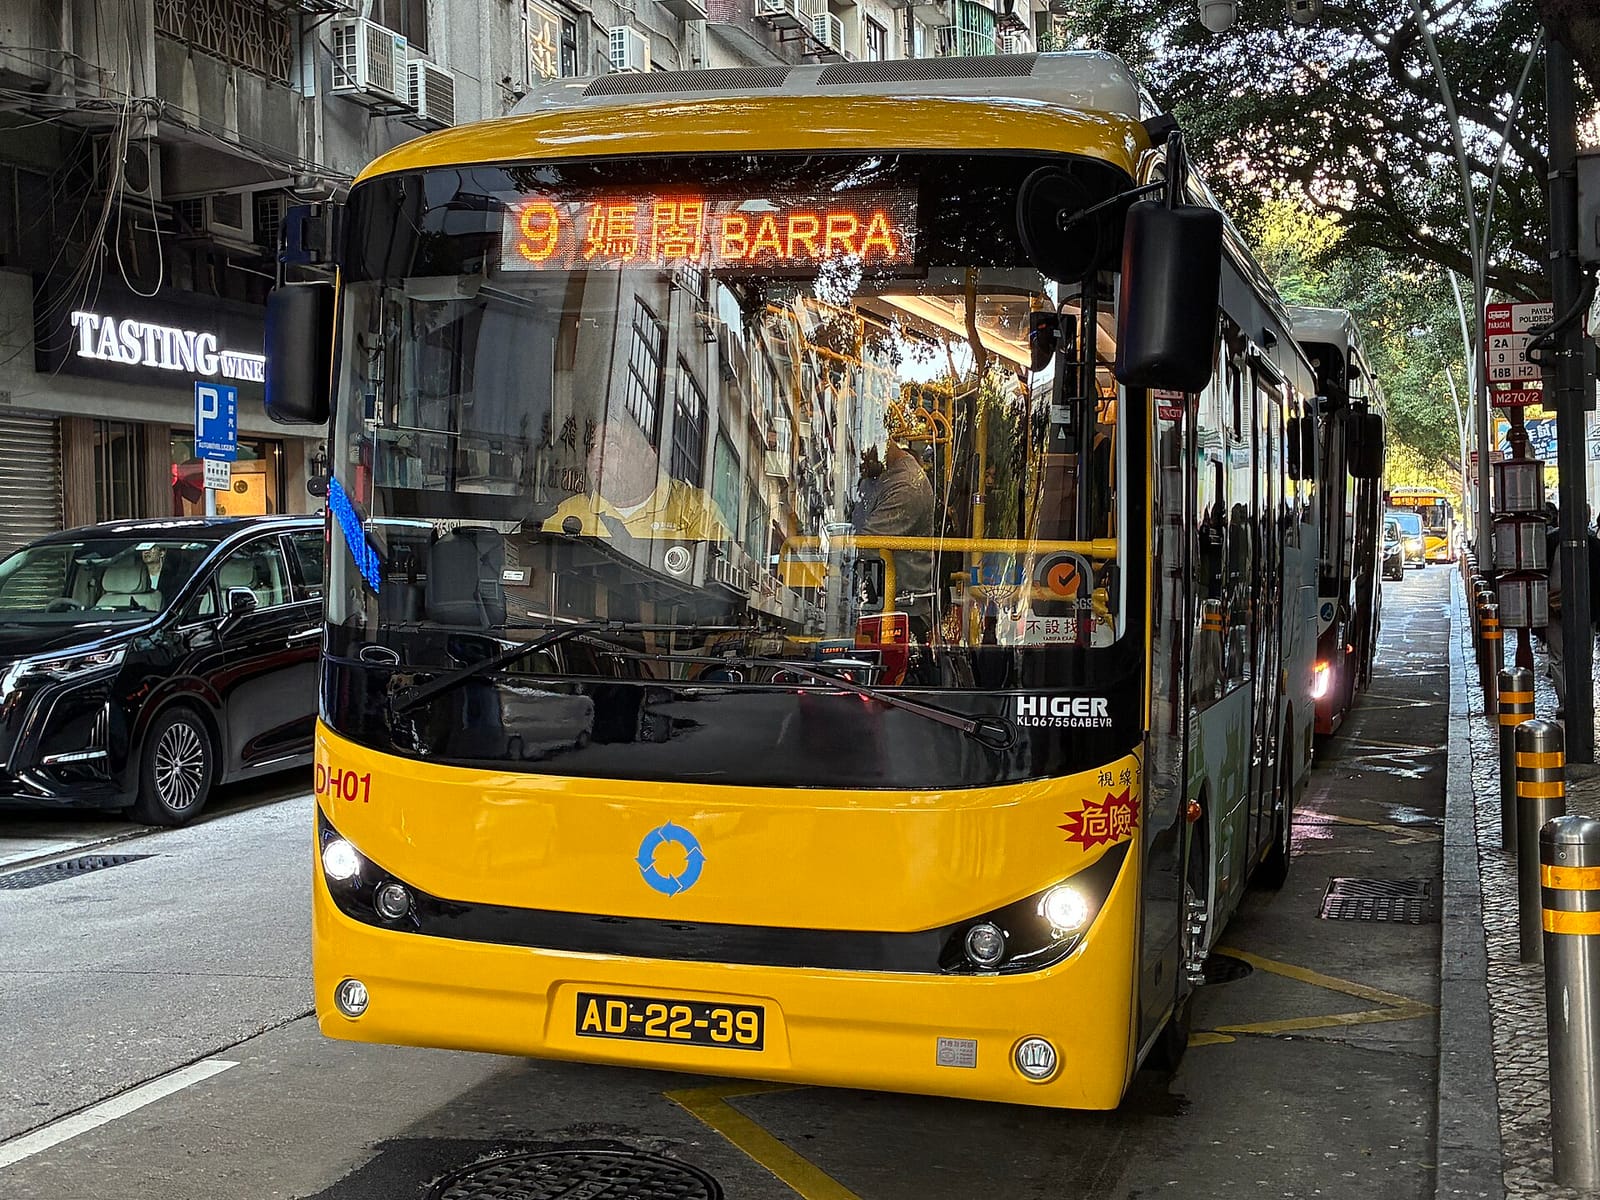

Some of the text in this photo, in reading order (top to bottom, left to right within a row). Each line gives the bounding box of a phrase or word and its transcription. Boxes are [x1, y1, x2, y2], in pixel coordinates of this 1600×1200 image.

[517, 200, 896, 261] 9 媽閣 BARRA
[1519, 315, 1554, 323] POLIDESP
[71, 311, 266, 383] TASTING WINE
[1494, 338, 1528, 348] 2A 7
[1498, 353, 1504, 363] 9
[1492, 367, 1533, 378] 18B H2
[1496, 392, 1539, 403] M270/2
[198, 386, 219, 437] P
[1017, 696, 1108, 717] HIGER
[1017, 717, 1112, 728] KLQ6755GABEVR
[316, 763, 371, 803] DH01
[1081, 803, 1132, 837] 危險
[581, 999, 759, 1044] AD-22-39
